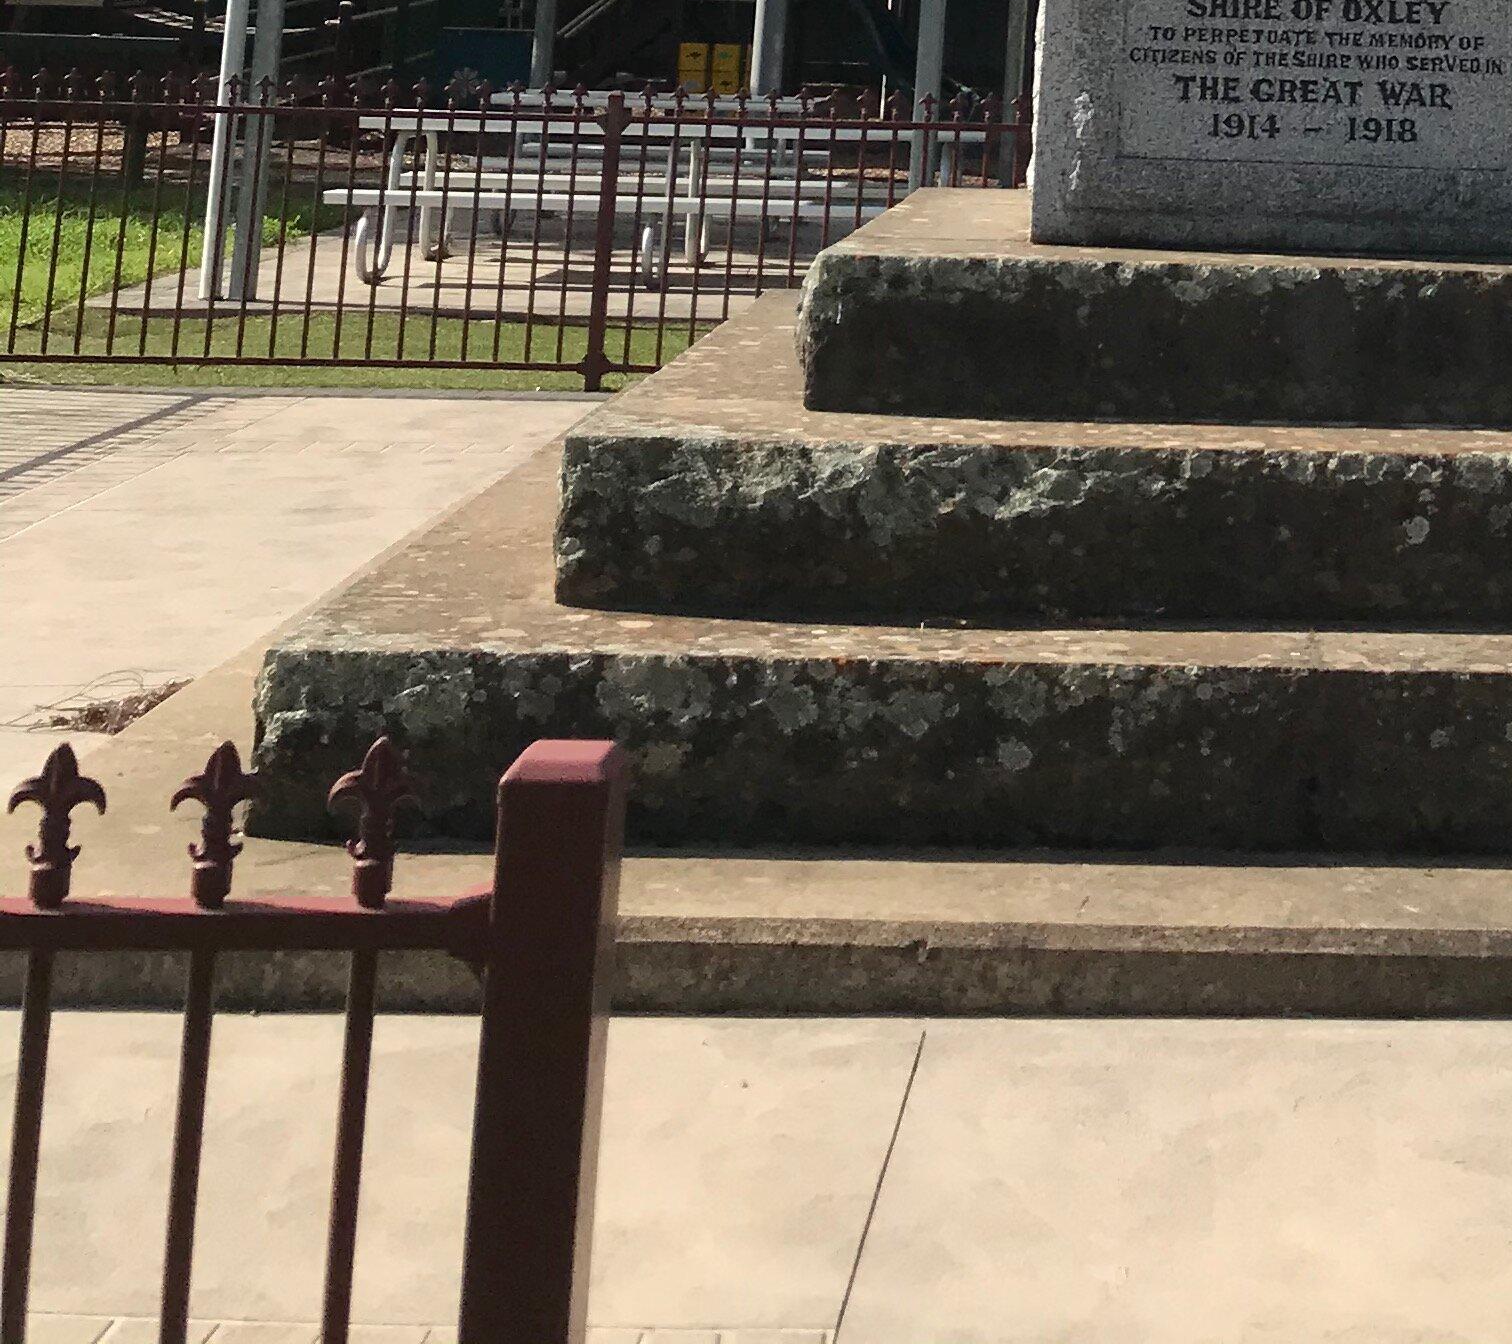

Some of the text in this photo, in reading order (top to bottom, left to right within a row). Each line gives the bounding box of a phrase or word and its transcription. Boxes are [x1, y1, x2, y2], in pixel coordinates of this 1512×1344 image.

[1149, 26, 1485, 50] TO PERPETUATE THE MEMORY OF
[1130, 47, 1216, 66] CITIZENS
[1223, 51, 1247, 65] OF
[1253, 51, 1289, 67] THE
[1357, 55, 1399, 70] WHO
[1406, 55, 1480, 73] SERVED
[1485, 57, 1503, 75] IN
[1173, 73, 1453, 110] THE GREAT WAR
[1208, 113, 1417, 144] 1914 1918
